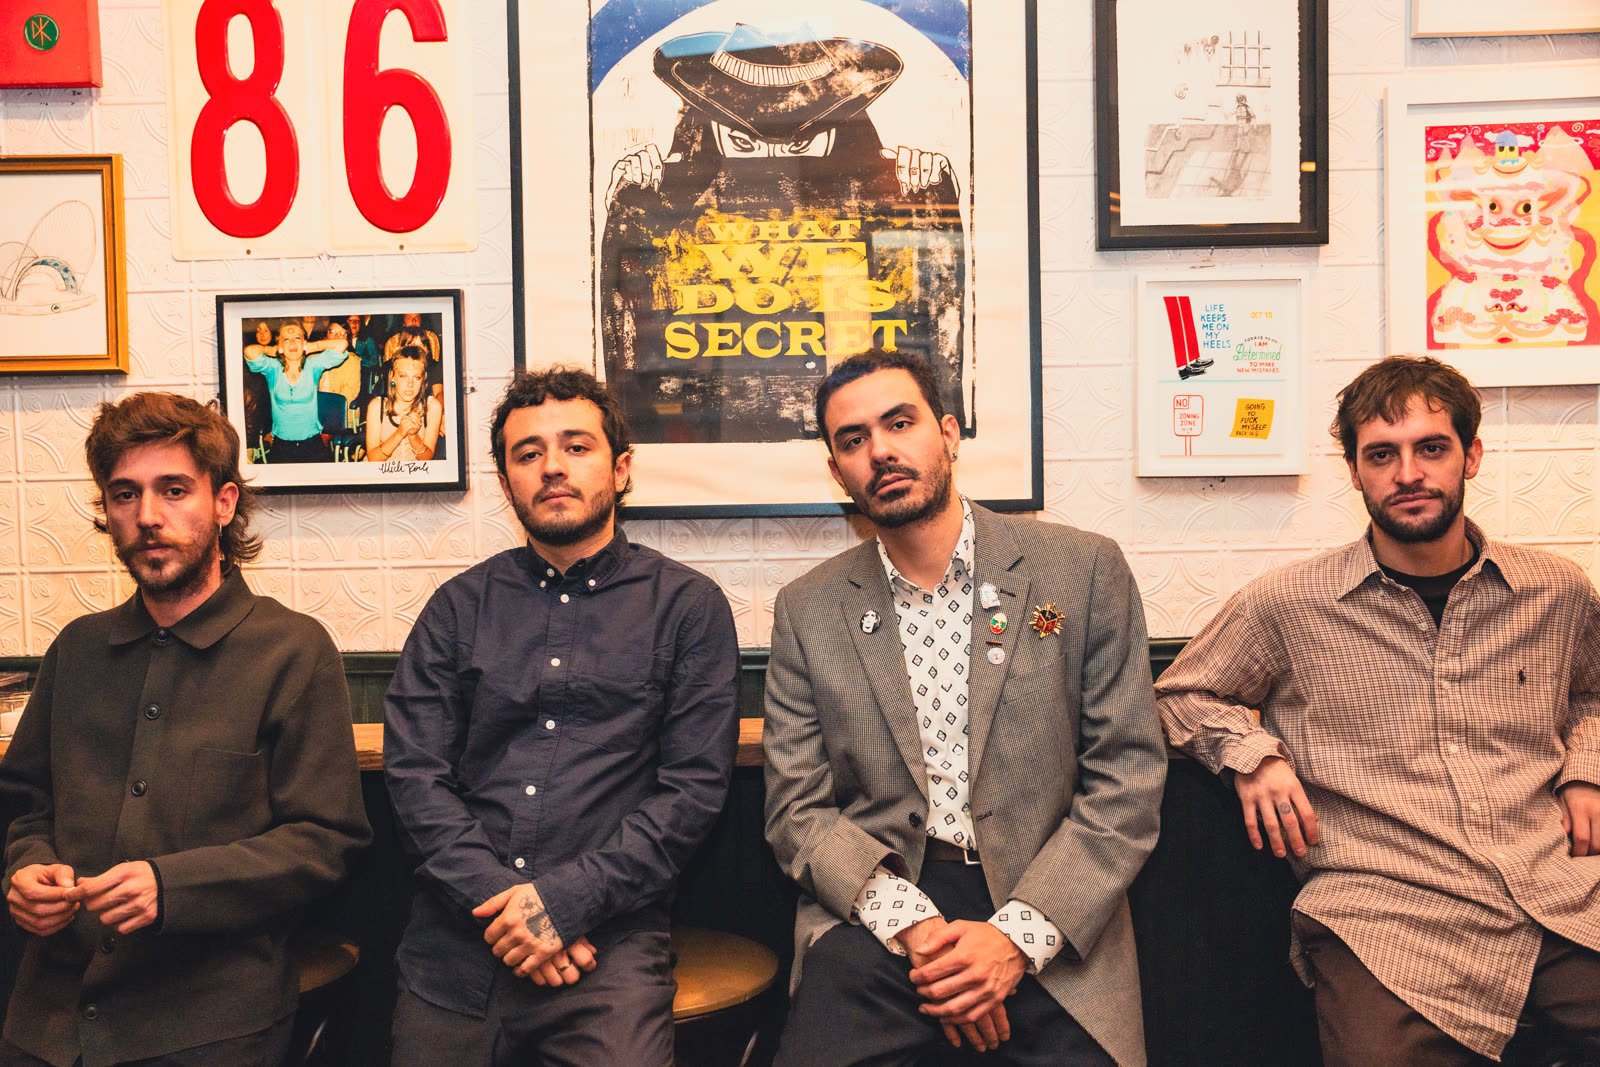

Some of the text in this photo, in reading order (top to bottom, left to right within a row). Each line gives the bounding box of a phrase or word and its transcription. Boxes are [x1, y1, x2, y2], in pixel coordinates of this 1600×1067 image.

[706, 219, 862, 241] WHAT
[696, 241, 869, 279] WE
[673, 279, 898, 315] DO IS
[1205, 304, 1224, 312] LIFE
[1200, 313, 1227, 323] KEEPS
[1202, 323, 1230, 331] ME ON
[664, 319, 908, 360] SECRET
[1205, 331, 1220, 339] MY
[1203, 339, 1231, 349] HEELS
[1175, 398, 1188, 408] NO
[1245, 403, 1266, 411] GOING
[1179, 412, 1200, 420] ZONING
[1240, 416, 1259, 424] FUCK
[1241, 423, 1268, 431] MYSELF
